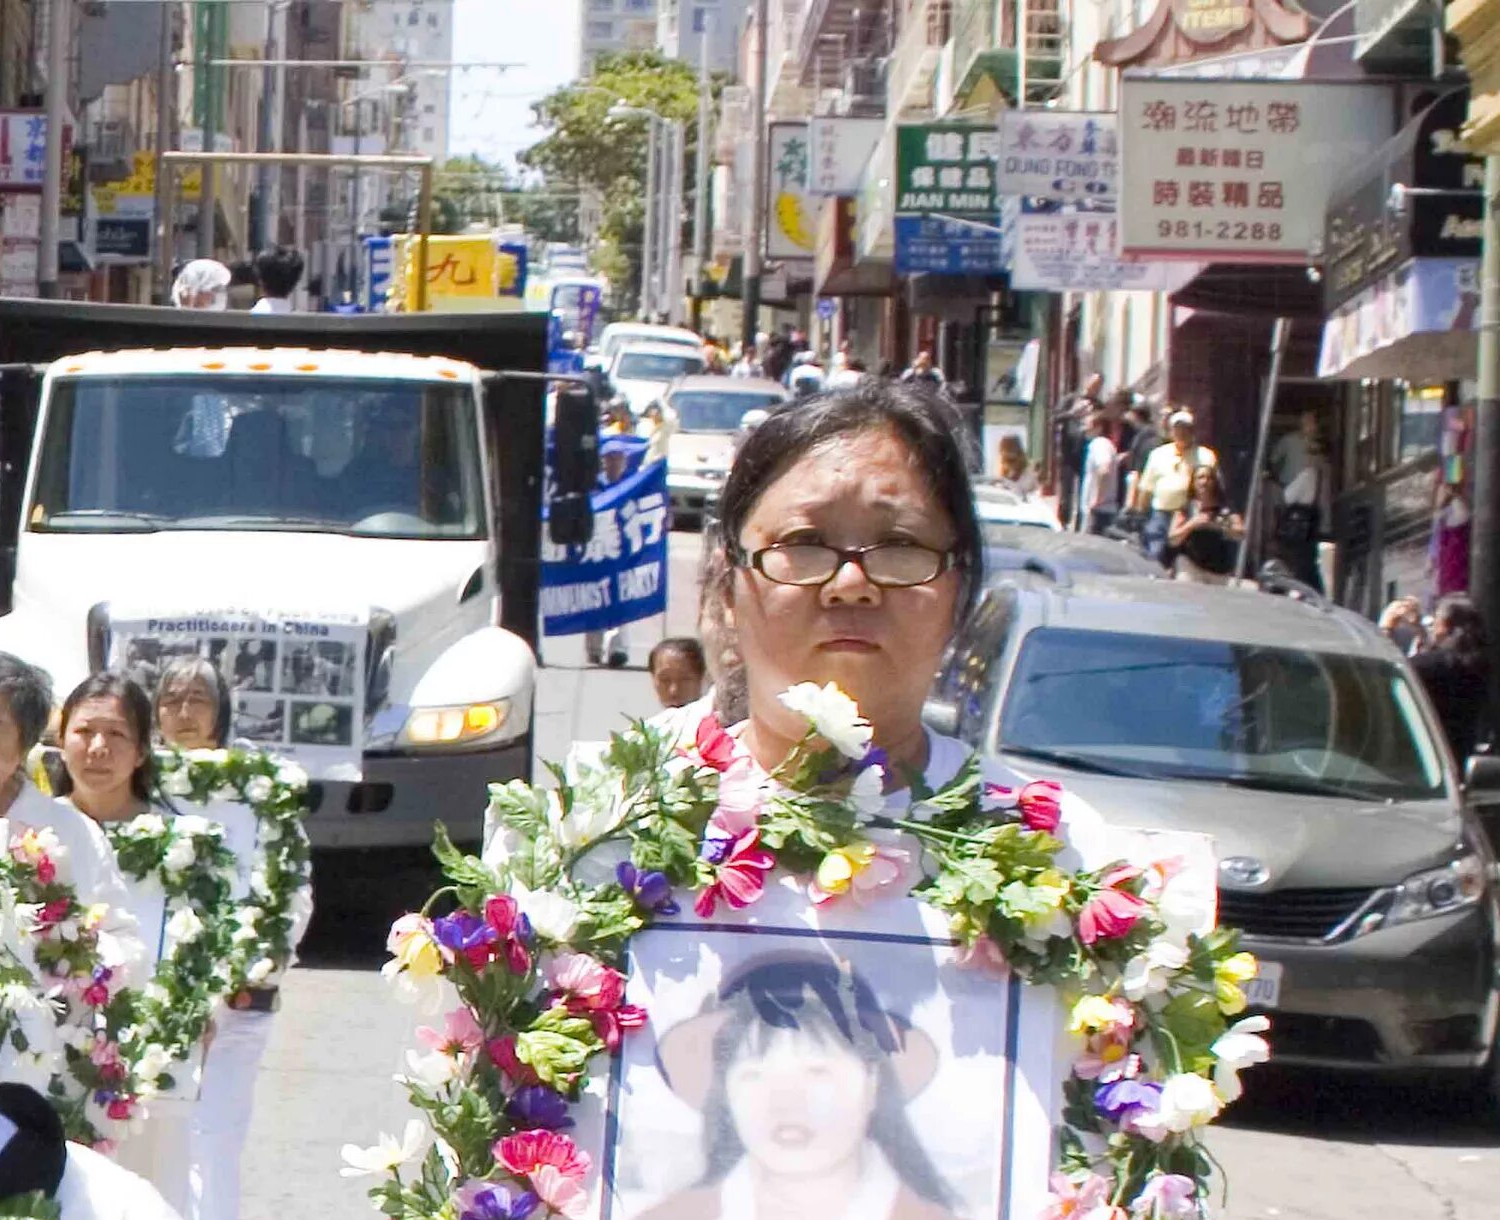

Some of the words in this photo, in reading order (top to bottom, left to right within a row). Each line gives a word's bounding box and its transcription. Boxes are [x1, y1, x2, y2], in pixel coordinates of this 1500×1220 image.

[1142, 100, 1299, 133] 潮流地帶
[900, 192, 944, 209] JIAN
[948, 192, 990, 209] MIN
[1153, 181, 1284, 209] 時裝精品
[1157, 219, 1283, 241] 981-2288
[147, 618, 257, 635] Practitioners
[261, 620, 277, 636] in
[283, 620, 330, 639] China
